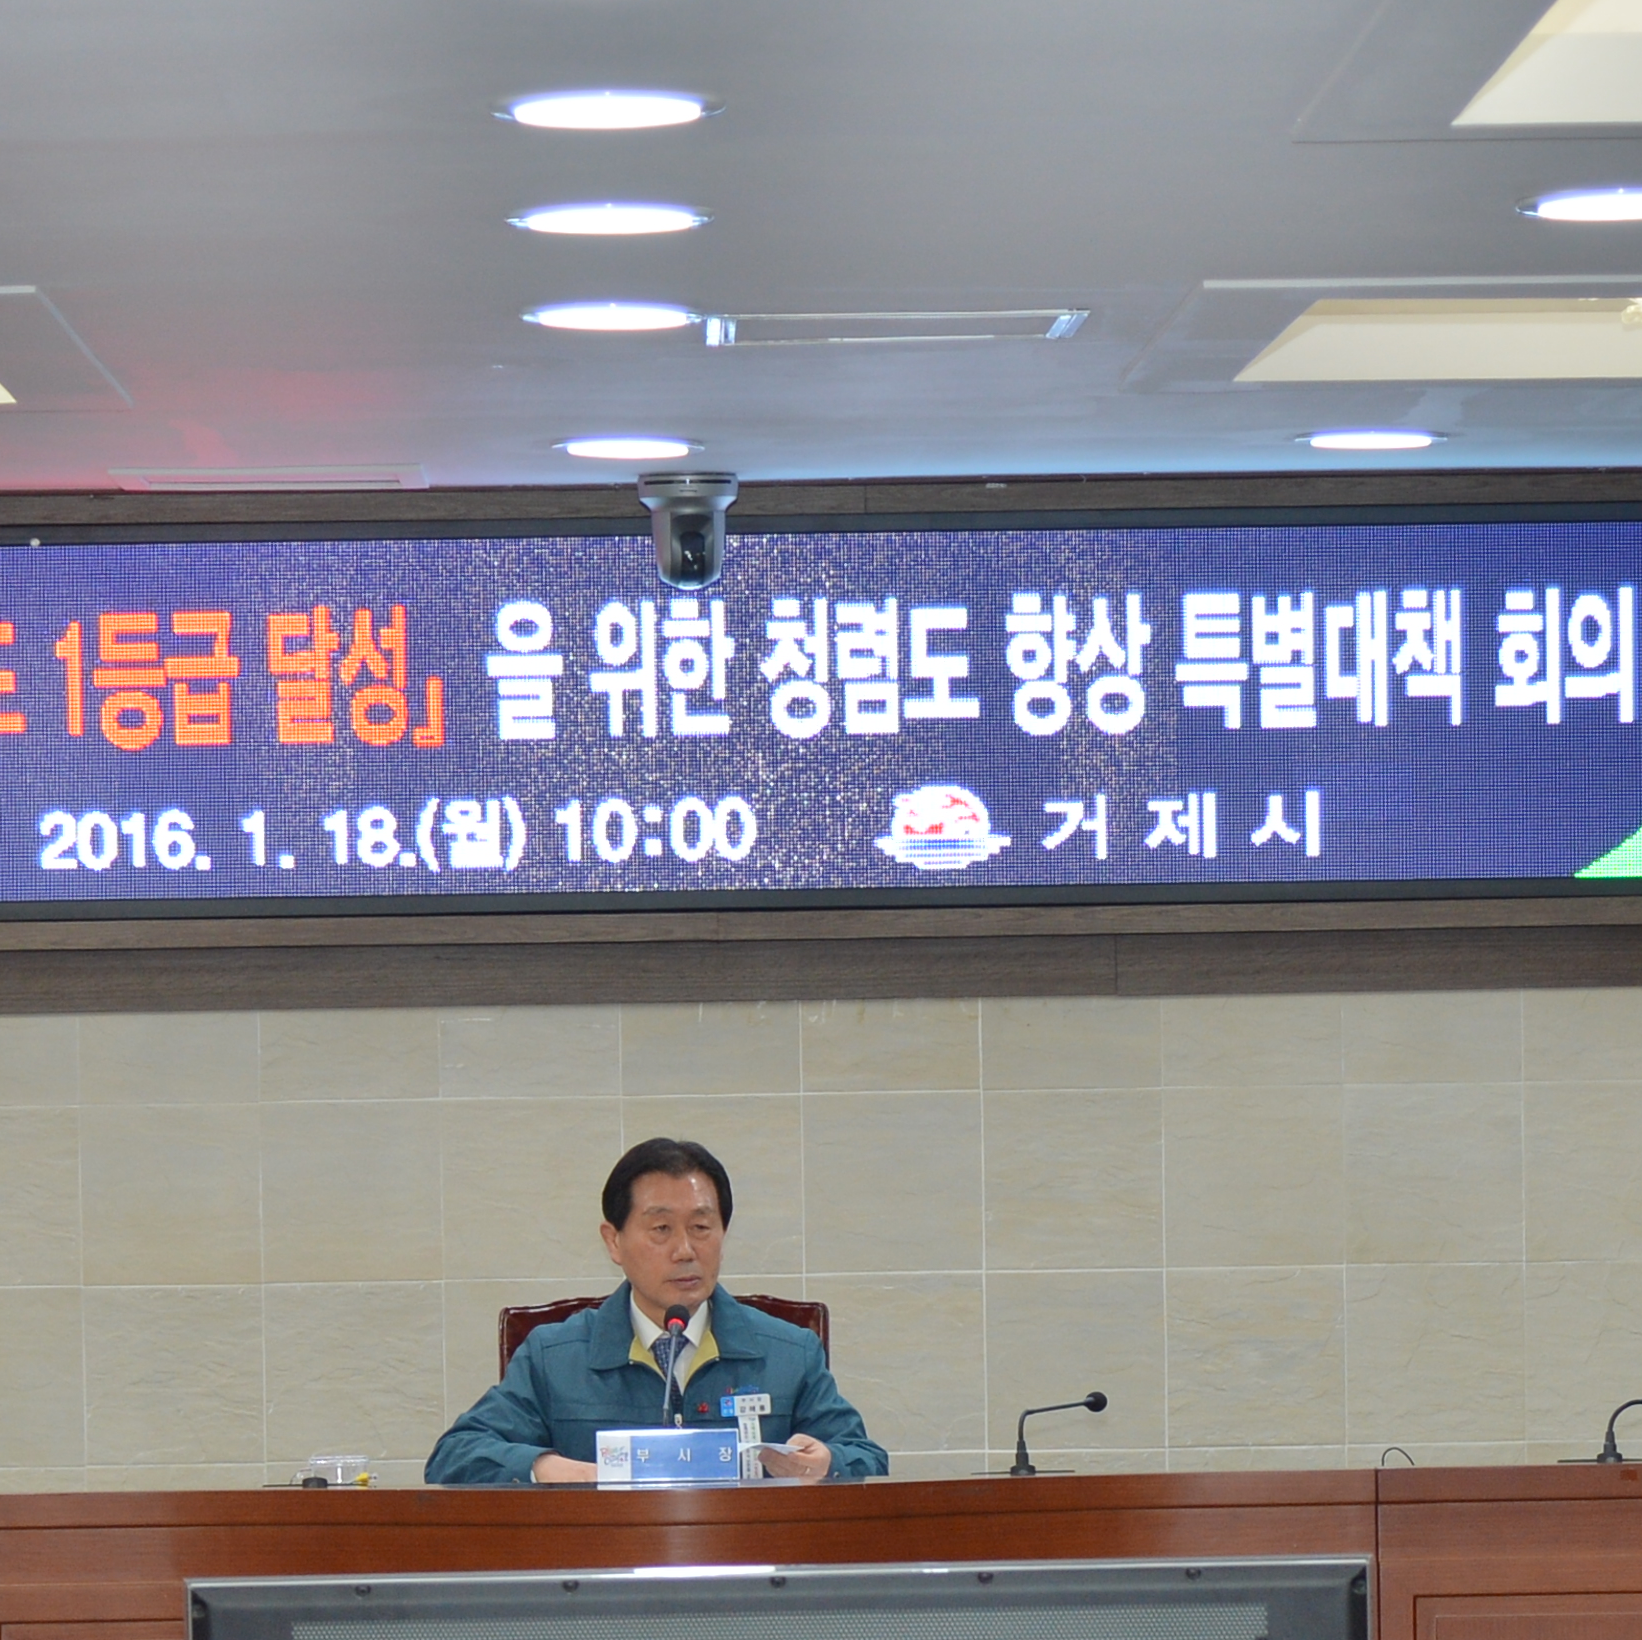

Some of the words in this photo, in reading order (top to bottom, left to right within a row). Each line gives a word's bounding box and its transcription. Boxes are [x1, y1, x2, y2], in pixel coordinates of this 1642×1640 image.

[54, 610, 241, 751] 1등급
[486, 599, 564, 740] 을
[588, 597, 736, 738] 위한
[758, 596, 980, 740] 청렴도
[1004, 592, 1152, 736] 향상
[1174, 589, 1462, 729] 특별대책
[1494, 586, 1634, 724] 회의
[38, 806, 212, 872] 2016.
[240, 808, 297, 870] 1.
[554, 796, 759, 864] 10:00
